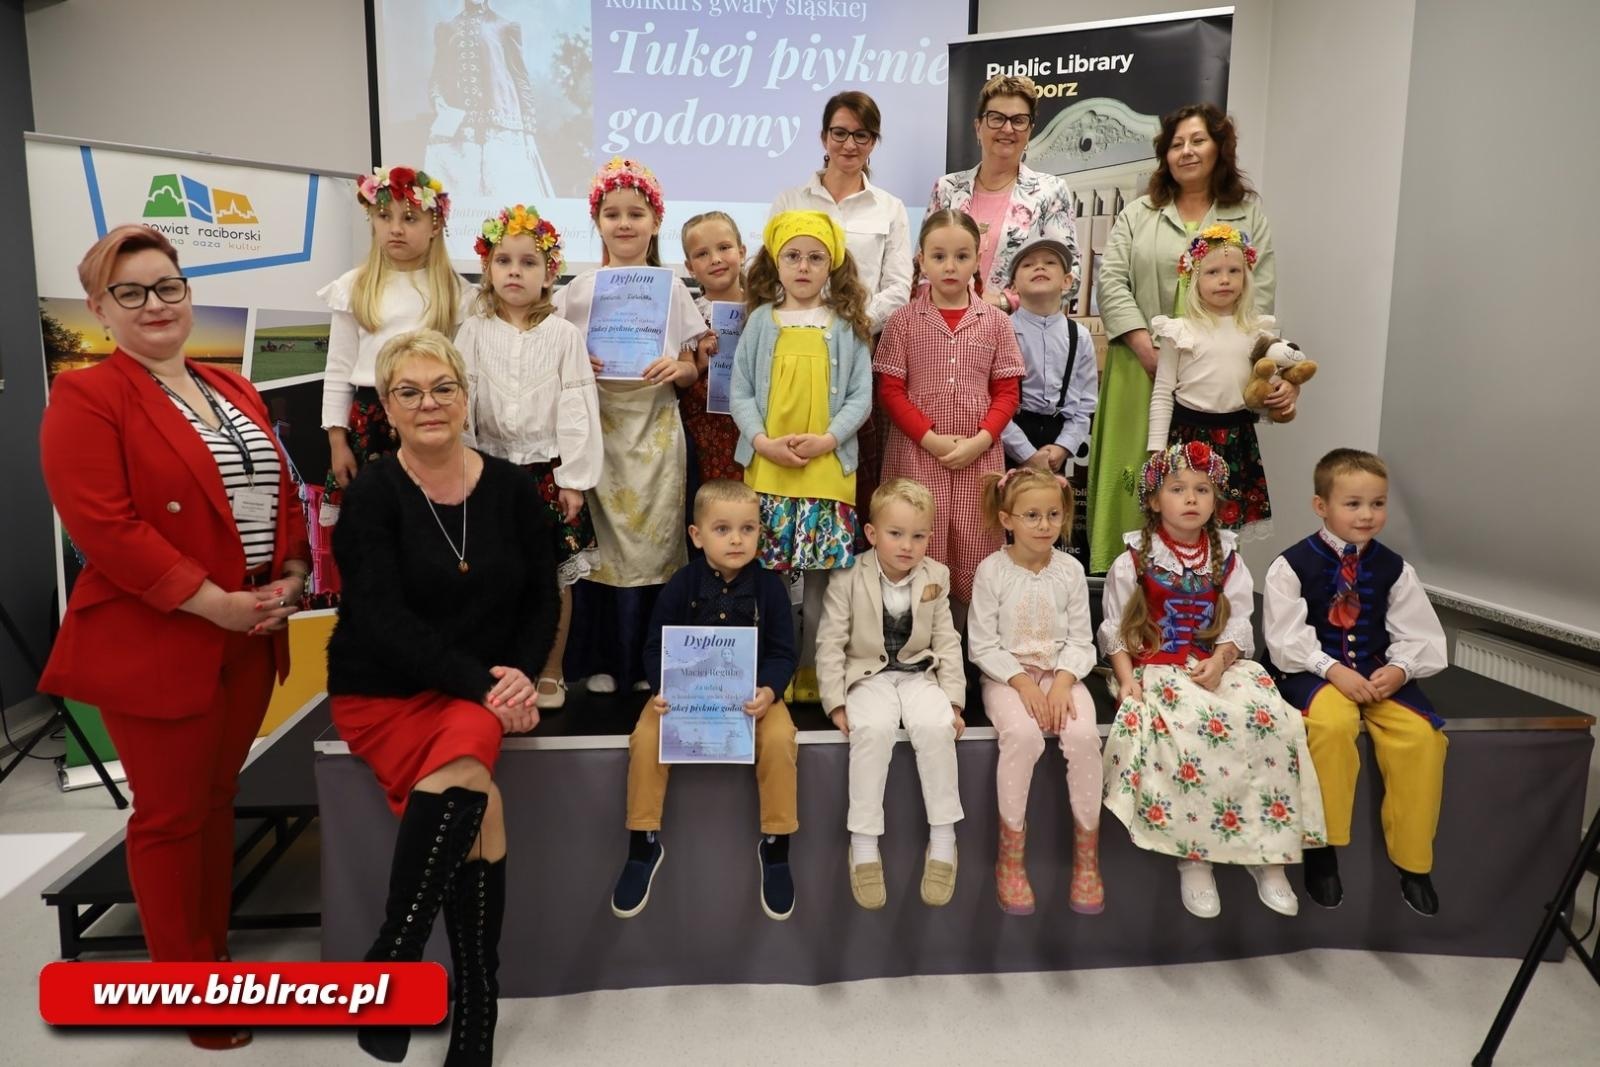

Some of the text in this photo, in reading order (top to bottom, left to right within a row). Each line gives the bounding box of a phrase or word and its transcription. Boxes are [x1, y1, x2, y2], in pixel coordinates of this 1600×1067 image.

[708, 0, 780, 19] gwary
[609, 21, 949, 91] Tukej piyknie
[986, 52, 1135, 80] Public Library
[1033, 81, 1078, 98] borz
[601, 98, 801, 158] godomy
[198, 228, 261, 241] raciborski
[192, 240, 221, 249] oaza
[610, 272, 655, 285] Dyplom
[684, 635, 735, 649] Dyplom
[721, 703, 744, 713] godo
